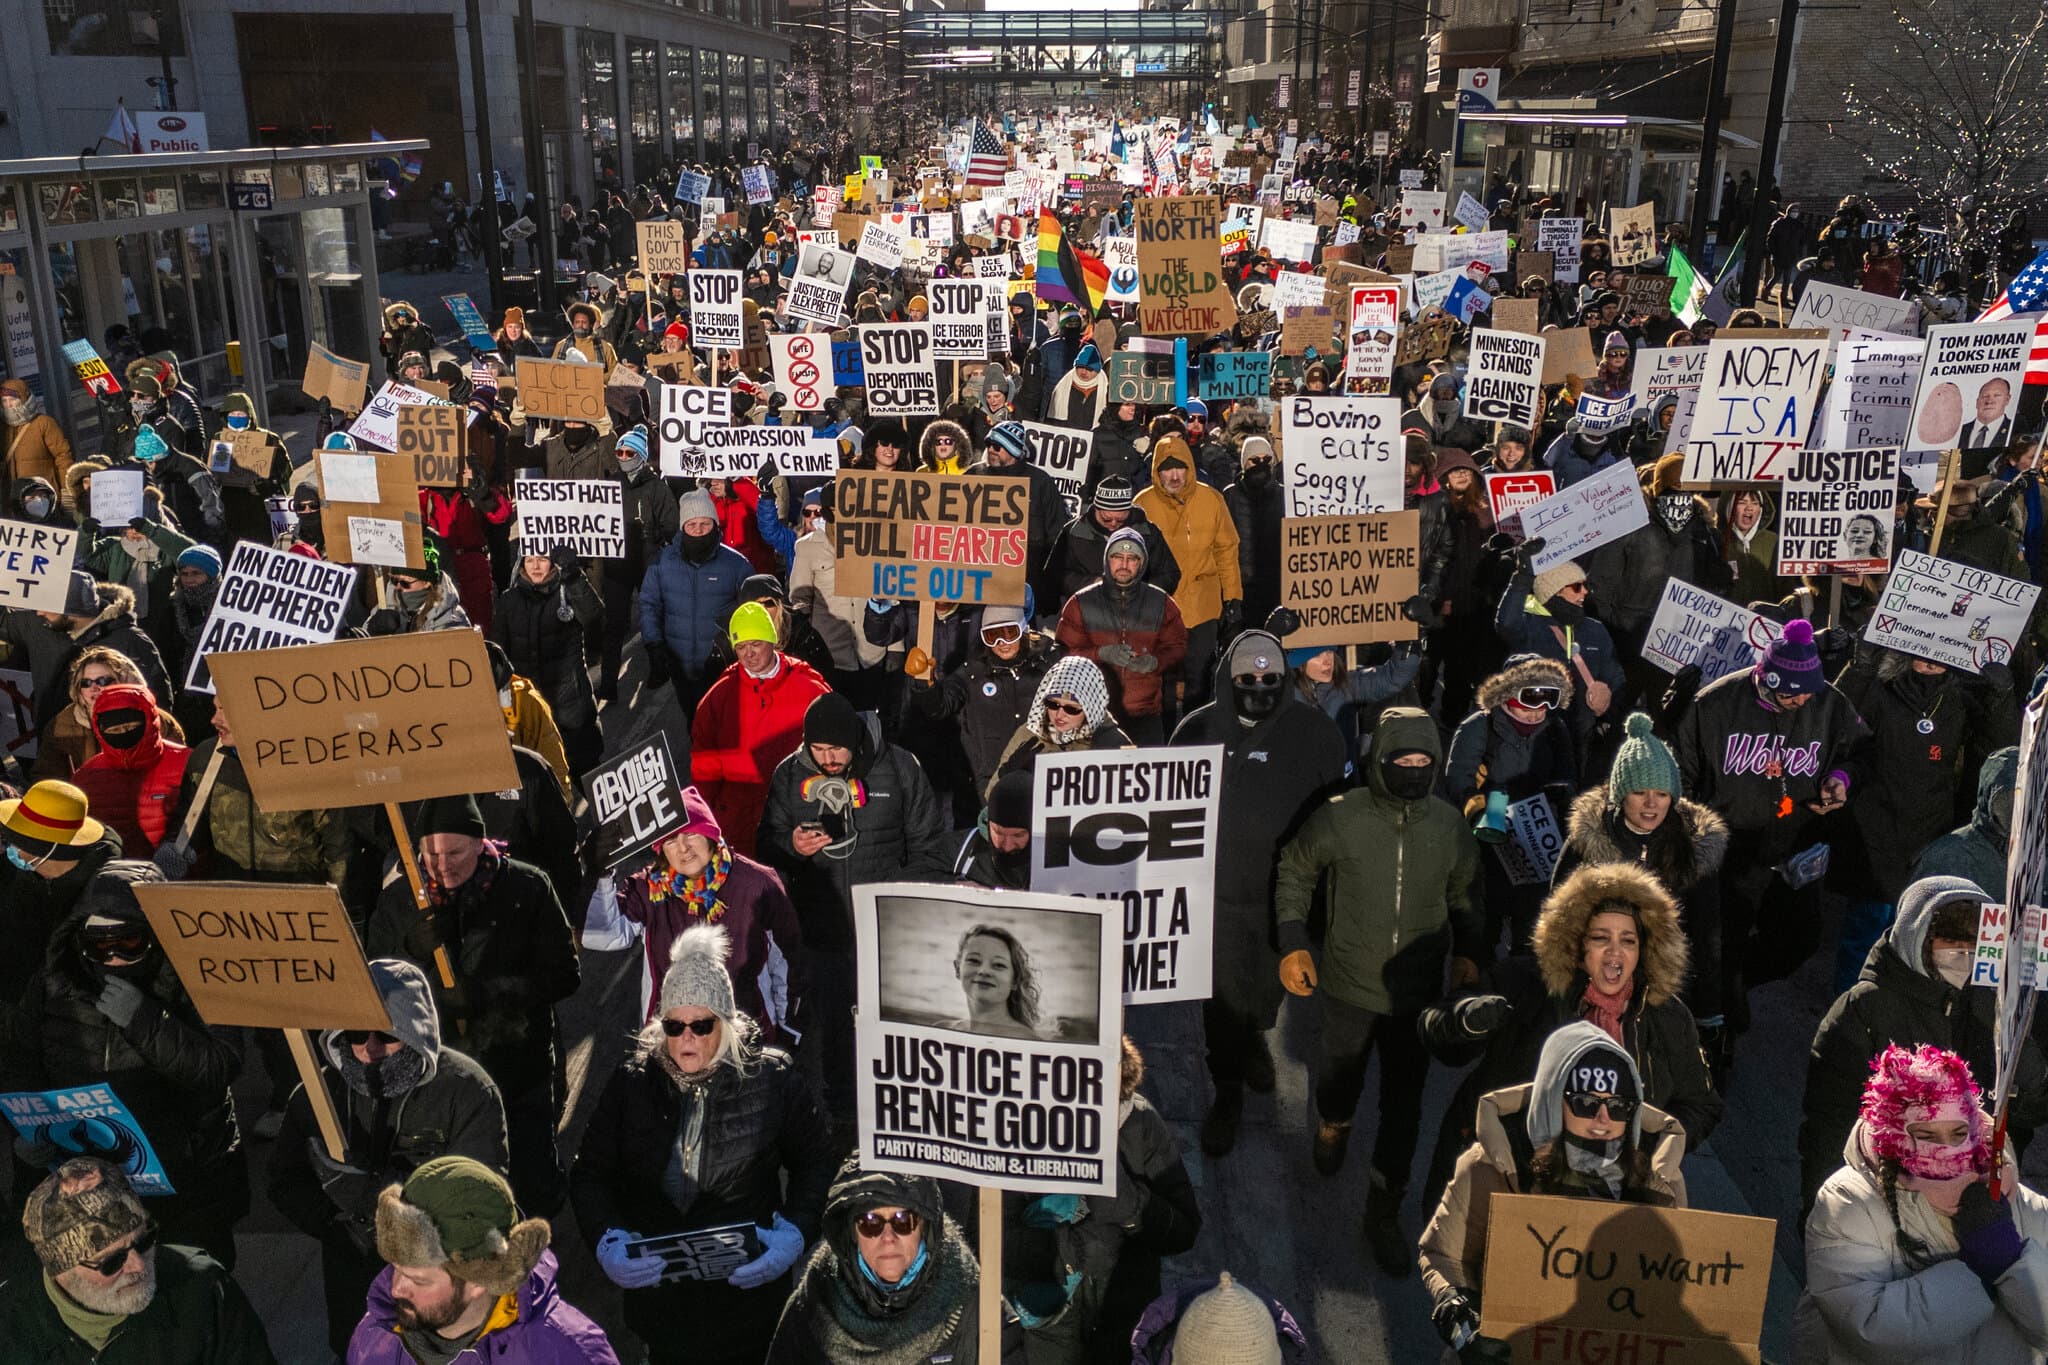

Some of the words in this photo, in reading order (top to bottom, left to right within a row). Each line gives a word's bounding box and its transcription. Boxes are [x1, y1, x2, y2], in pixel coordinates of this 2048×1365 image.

[150, 139, 198, 152] Public
[1138, 202, 1152, 218] WE
[1162, 202, 1185, 218] ARE
[1190, 200, 1215, 217] THE
[1236, 206, 1255, 225] ICE
[645, 225, 674, 239] THIS
[886, 232, 901, 246] ICE
[1141, 217, 1216, 242] NORTH
[1224, 230, 1246, 242] OUT
[1340, 224, 1355, 233] ICE
[1340, 233, 1355, 242] OUT
[646, 240, 681, 255] GOV'T
[649, 257, 682, 271] SUCKS
[981, 264, 1004, 272] OUT
[1119, 255, 1137, 265] ICE
[1162, 258, 1188, 272] THE
[693, 274, 738, 304] STOP
[794, 282, 827, 303] JUSTICE
[827, 288, 842, 304] FOR
[1143, 271, 1217, 296] WORLD
[790, 294, 811, 311] ALEX
[810, 299, 839, 316] PRETTI
[932, 284, 983, 314] STOP
[1167, 294, 1189, 310] IS
[695, 312, 707, 325] ICE
[707, 312, 740, 327] TERROR
[1145, 307, 1220, 332] WATCHING
[1801, 292, 1833, 319] NO
[1833, 298, 1903, 333] SECRET
[695, 325, 739, 337] NOW!
[932, 324, 947, 337] ICE
[949, 324, 984, 337] TERROR
[1939, 336, 1969, 349] TOM
[1972, 332, 2028, 347] HOMAN
[863, 329, 929, 364] STOP
[933, 338, 984, 348] NOW!
[1475, 335, 1541, 358] MINNESOTA
[1938, 348, 1984, 363] LOOKS
[1988, 347, 2020, 360] LIKE
[524, 362, 591, 390] ICE
[1119, 360, 1171, 379] ICE
[1203, 357, 1225, 373] No
[1233, 356, 1268, 371] More
[1480, 354, 1533, 377] STANDS
[1718, 346, 1821, 389] NOEM
[1930, 366, 1939, 376] A
[1941, 363, 1989, 376] CANNED
[1992, 361, 2021, 373] HAM
[868, 372, 934, 389] DEPORTING
[1119, 380, 1176, 400] OUT
[1648, 373, 1672, 385] NOT
[1845, 376, 1870, 385] are
[1879, 376, 1908, 386] not
[523, 389, 599, 416] GTFO
[668, 388, 727, 417] ICE
[869, 389, 936, 406] OUR
[1470, 378, 1536, 406] AGAINST
[400, 407, 450, 427] ICE
[871, 405, 915, 413] FAMILIES
[1292, 398, 1382, 430] Bovino
[1468, 397, 1532, 425] ICE
[1586, 400, 1606, 416] ICE
[1712, 395, 1771, 436] IS
[1774, 396, 1797, 438] A
[1840, 409, 1873, 424] The
[400, 428, 455, 451] OUT
[704, 429, 806, 447] COMPASSION
[1025, 428, 1089, 472] STOP
[1320, 433, 1390, 462] eats
[710, 455, 725, 472] IS
[729, 453, 760, 471] NOT
[780, 451, 833, 473] CRIME
[1788, 450, 1897, 482] JUSTICE
[516, 482, 576, 501] RESIST
[578, 484, 622, 504] HATE
[1294, 463, 1367, 504] Soggy
[1821, 482, 1860, 491] FOR
[837, 477, 932, 521] CLEAR
[938, 481, 1028, 526] EYES
[1785, 491, 1841, 512] RENEE
[1844, 489, 1894, 511] GOOD
[1530, 504, 1571, 528] ICE
[1784, 517, 1842, 537] KILLED
[836, 521, 907, 559] FULL
[911, 523, 1027, 567] HEARTS
[1288, 525, 1322, 547] HEY
[1326, 523, 1351, 545] ICE
[1357, 522, 1389, 543] THE
[1288, 550, 1362, 574] GESTAPO
[1368, 547, 1415, 569] WERE
[1782, 540, 1806, 559] BY
[1809, 540, 1838, 559] ICE
[232, 546, 269, 578] MN
[266, 555, 351, 600] GOLDEN
[873, 563, 918, 597] ICE
[929, 566, 993, 602] OUT
[1901, 550, 1952, 579] USES
[1957, 567, 1993, 593] FOR
[1289, 580, 1333, 601] ALSO
[1341, 574, 1380, 596] LAW
[1913, 581, 1948, 599] coffee
[219, 575, 341, 634] GOPHERS
[1902, 599, 1949, 620] lemonade
[1729, 611, 1748, 633] IS
[1894, 618, 1937, 642] national
[1938, 633, 1976, 655] security
[254, 658, 473, 711] DONDOLD
[256, 723, 449, 769] PEDERASS
[1723, 732, 1822, 777] Wolves
[592, 746, 668, 826] ABOLISH
[1045, 759, 1212, 807] PROTESTING
[1527, 799, 1550, 830] ICE
[1044, 808, 1207, 869] ICE
[1522, 820, 1551, 878] MINNESOTA
[1169, 886, 1190, 936] A
[170, 909, 339, 943] DONNIE
[199, 958, 336, 985] ROTTEN
[872, 1034, 1023, 1099] JUSTICE
[1030, 1053, 1104, 1106] FOR
[1571, 1068, 1619, 1095] 1989
[3, 1096, 49, 1113] WE
[57, 1089, 113, 1110] ARE
[13, 1105, 122, 1126] MINNESOTA
[875, 1083, 988, 1145] RENEE
[995, 1100, 1101, 1155] GOOD
[877, 1138, 917, 1157] PARTY
[916, 1144, 941, 1161] FOR
[942, 1146, 1006, 1173] SOCIALISM
[1008, 1158, 1025, 1174] &
[1026, 1157, 1099, 1180] LIBERATION
[1640, 1251, 1744, 1286] want
[1607, 1286, 1646, 1319] a
[1532, 1320, 1686, 1365] FIGHT
